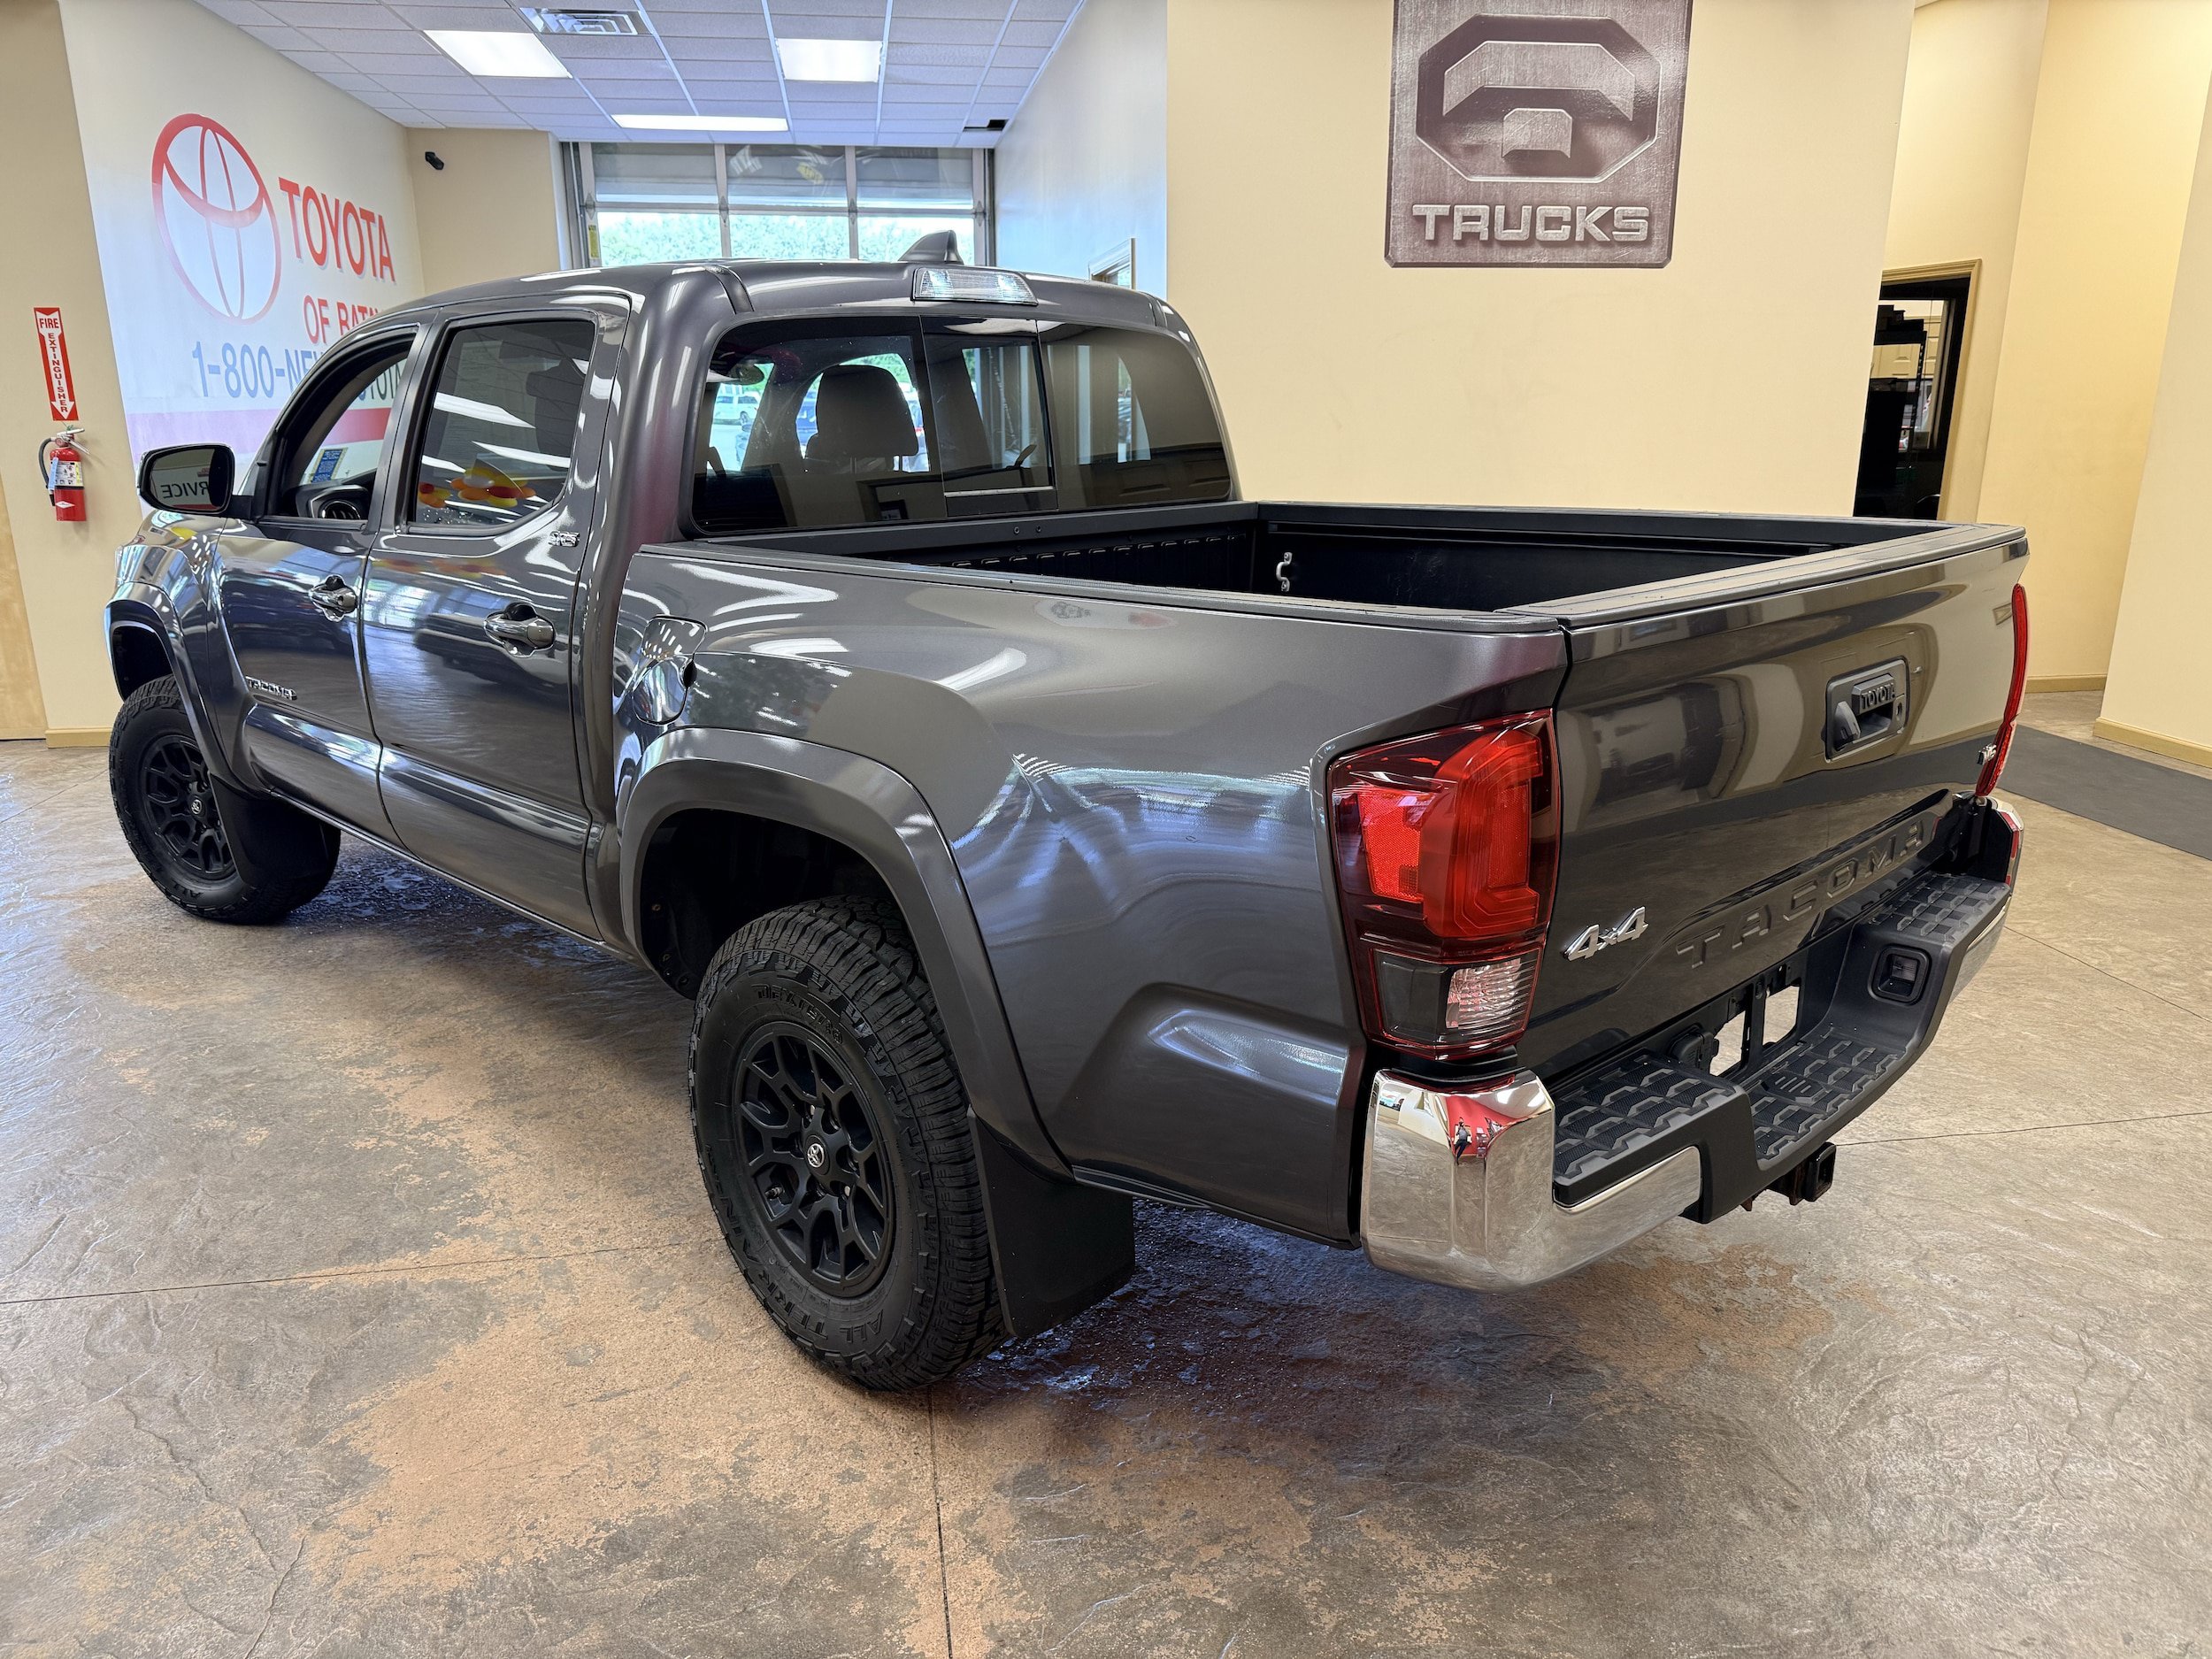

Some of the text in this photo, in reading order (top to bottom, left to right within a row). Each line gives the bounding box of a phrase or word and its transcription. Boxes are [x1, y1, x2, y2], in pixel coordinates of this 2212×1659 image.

[278, 176, 396, 283] TOYOTA
[1412, 204, 1650, 242] TRUCKS
[39, 318, 59, 329] FIRE
[303, 295, 330, 344] OF
[48, 332, 68, 413] EXTINGUISHER
[245, 675, 297, 700] TACOMA
[1676, 819, 1924, 969] TACOMA
